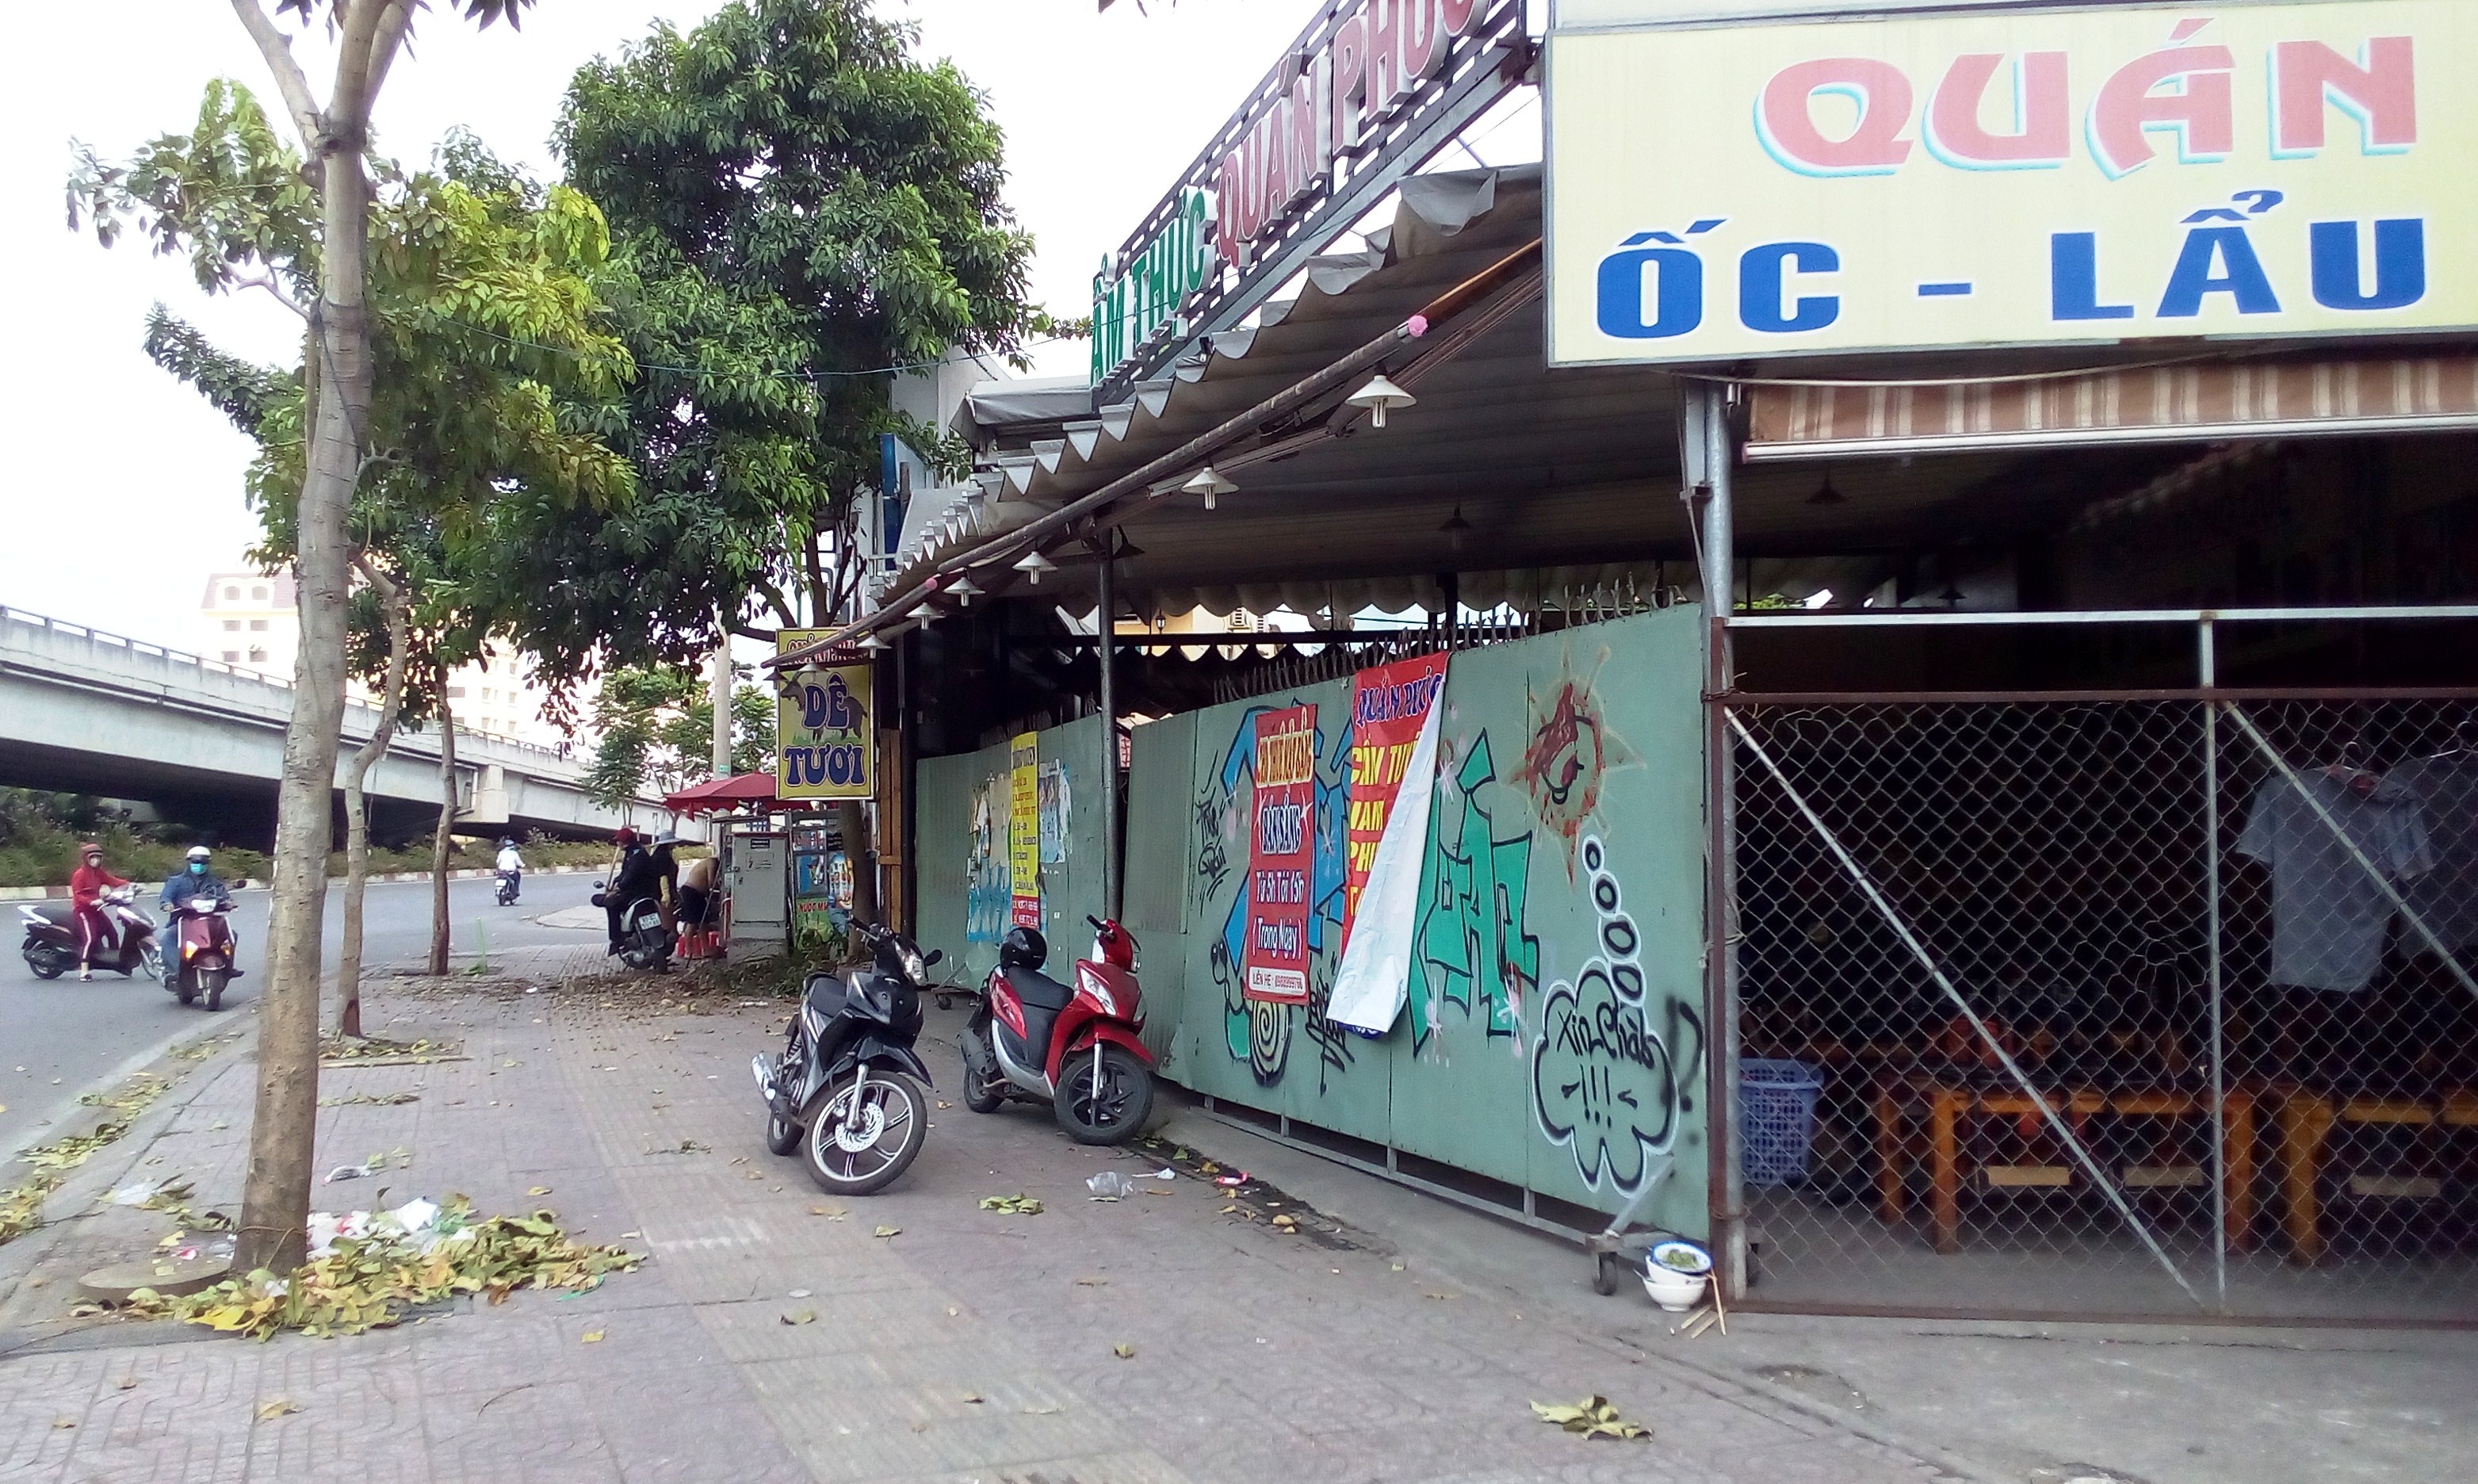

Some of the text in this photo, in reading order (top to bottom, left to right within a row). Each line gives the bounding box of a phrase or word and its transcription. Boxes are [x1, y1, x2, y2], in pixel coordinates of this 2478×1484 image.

[1753, 18, 2416, 180] QUÁN
[1091, 252, 1133, 388] ẨM
[1218, 52, 1330, 268] QUÁN
[1333, 0, 1487, 156] PH
[1597, 218, 1840, 338] ỐC
[2051, 189, 2425, 321] LẨU
[802, 672, 849, 729] DÊ
[1356, 676, 1401, 729] QUÁN
[783, 743, 866, 786] TƯƠI
